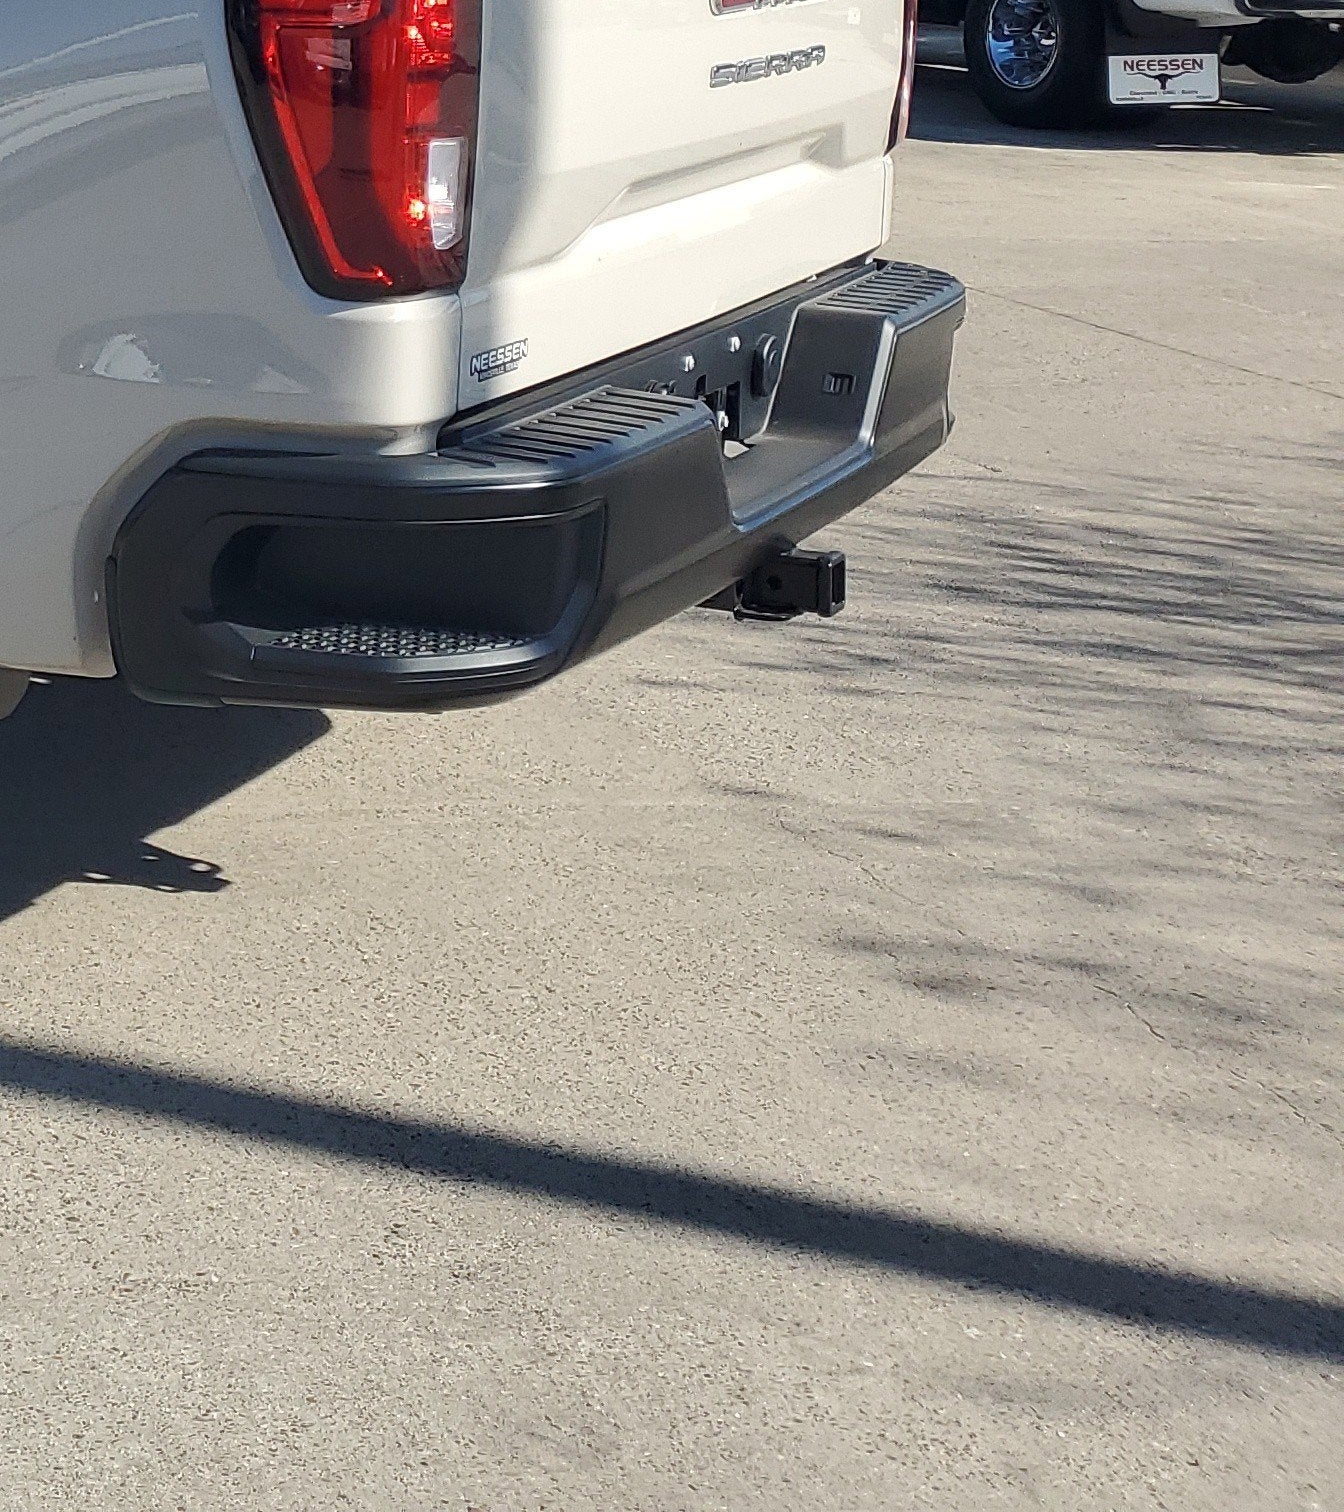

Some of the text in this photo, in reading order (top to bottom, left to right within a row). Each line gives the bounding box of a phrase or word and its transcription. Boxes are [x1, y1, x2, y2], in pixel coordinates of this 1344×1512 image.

[710, 44, 825, 88] SIERRA
[1124, 59, 1203, 71] NEESSEN
[470, 339, 528, 376] NEESSEN
